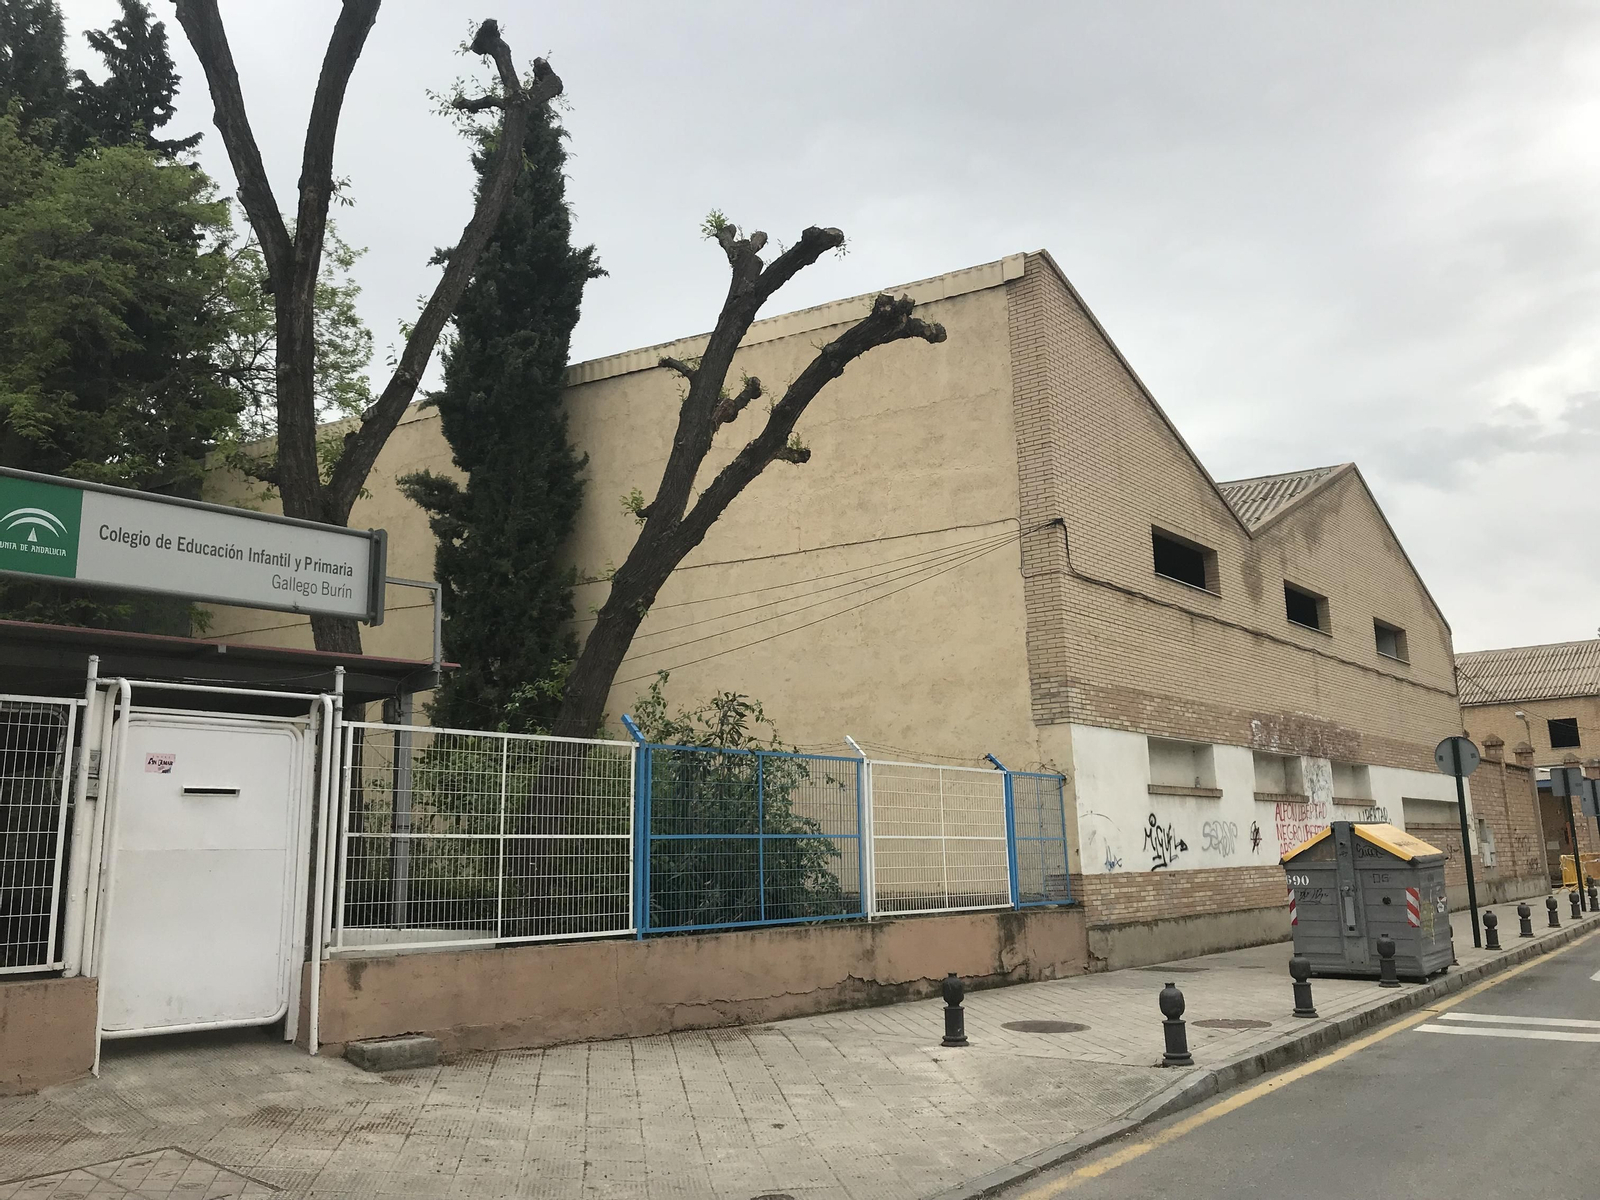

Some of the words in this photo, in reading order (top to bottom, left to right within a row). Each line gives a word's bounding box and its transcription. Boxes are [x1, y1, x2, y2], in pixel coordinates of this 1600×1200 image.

[0, 541, 17, 550] UNTA
[20, 543, 28, 551] DE
[99, 524, 151, 548] Colegio
[155, 533, 172, 549] de
[177, 536, 243, 561] Educación
[248, 547, 291, 568] Infantil
[294, 557, 302, 572] y
[304, 556, 353, 577] Primaria
[271, 574, 318, 597] Gallego
[321, 581, 352, 599] Burín
